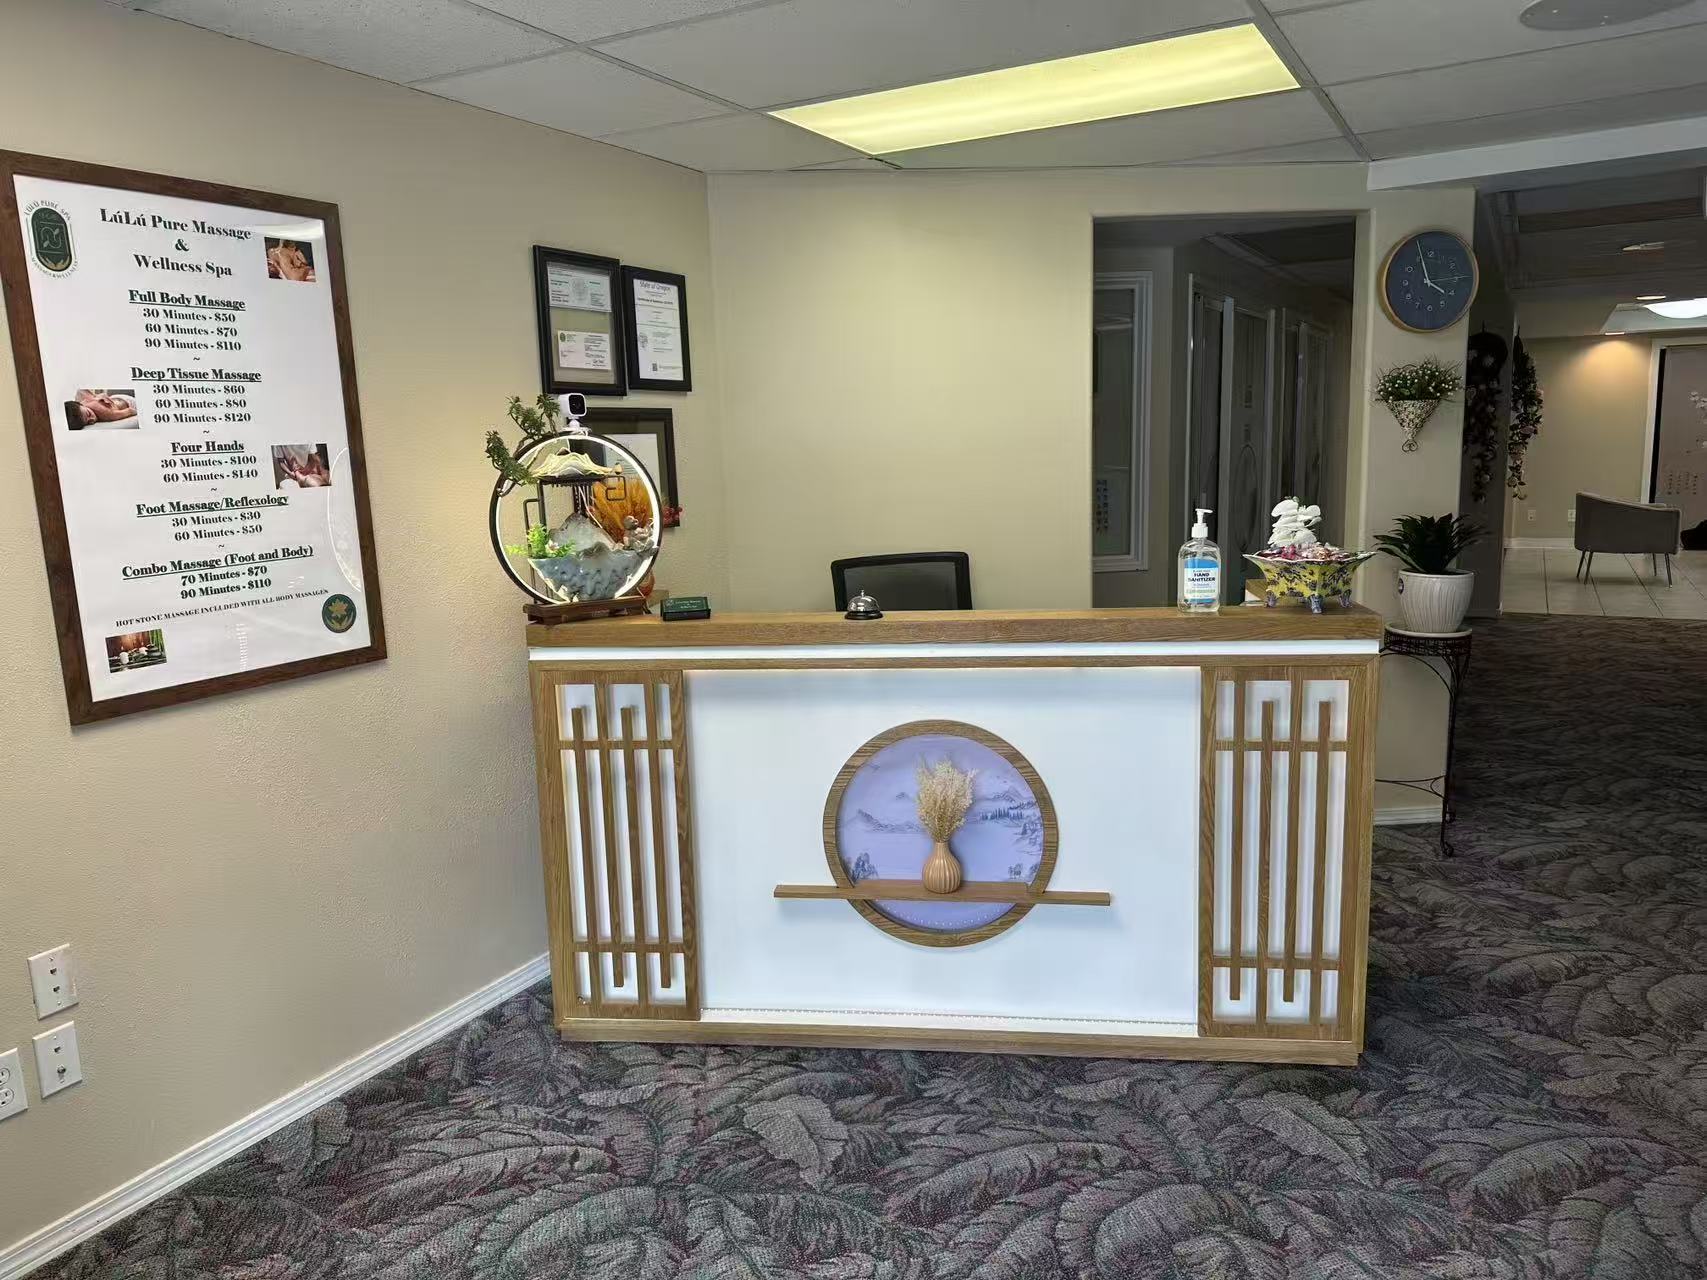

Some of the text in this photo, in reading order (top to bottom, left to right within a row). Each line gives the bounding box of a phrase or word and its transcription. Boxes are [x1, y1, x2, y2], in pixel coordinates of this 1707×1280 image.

[100, 208, 251, 241] LúLú Pure Massage
[175, 238, 190, 252] &
[133, 254, 233, 278] Wellness Spa
[128, 289, 246, 312] Full Body Massage
[143, 308, 160, 318] 30
[163, 309, 207, 321] Minutes
[214, 312, 236, 323] $50
[145, 323, 161, 333] 60
[164, 324, 209, 335] Minutes
[216, 327, 238, 338] $70
[144, 338, 161, 348] 90
[164, 338, 209, 350] Minutes
[216, 341, 242, 351] $110
[130, 367, 262, 383] Deep Tissue Massage
[153, 384, 170, 394] 30
[172, 384, 216, 394] Minutes
[223, 385, 245, 395] $60
[155, 399, 171, 408] 60
[174, 399, 218, 408] Minutes
[225, 399, 247, 408] $80
[154, 414, 170, 423] 90
[173, 413, 217, 423] Minutes
[224, 413, 251, 422] $120
[170, 440, 245, 453] Four Hands
[161, 459, 177, 468] 30
[179, 458, 223, 468] Minutes
[230, 455, 257, 465] $100
[163, 473, 179, 483] 60
[182, 472, 225, 482] Minutes
[232, 469, 258, 479] $140
[136, 494, 289, 516] Foot Massage/Reflexology
[172, 517, 188, 527] 30
[190, 515, 233, 525] Minutes
[240, 511, 261, 521] $30
[174, 531, 190, 541] 60
[192, 529, 235, 539] Minutes
[242, 524, 263, 535] $50
[122, 545, 314, 578] Combo Massage (Foot and Body)
[181, 574, 196, 587] 70
[198, 571, 240, 583] Minutes
[247, 565, 268, 577] $70
[180, 588, 197, 599] 90
[198, 585, 241, 596] Minutes
[247, 578, 272, 590] $110
[116, 618, 134, 627] HOT
[135, 614, 163, 623] STONE
[164, 608, 200, 619] MASSAGE
[240, 599, 260, 607] WITH
